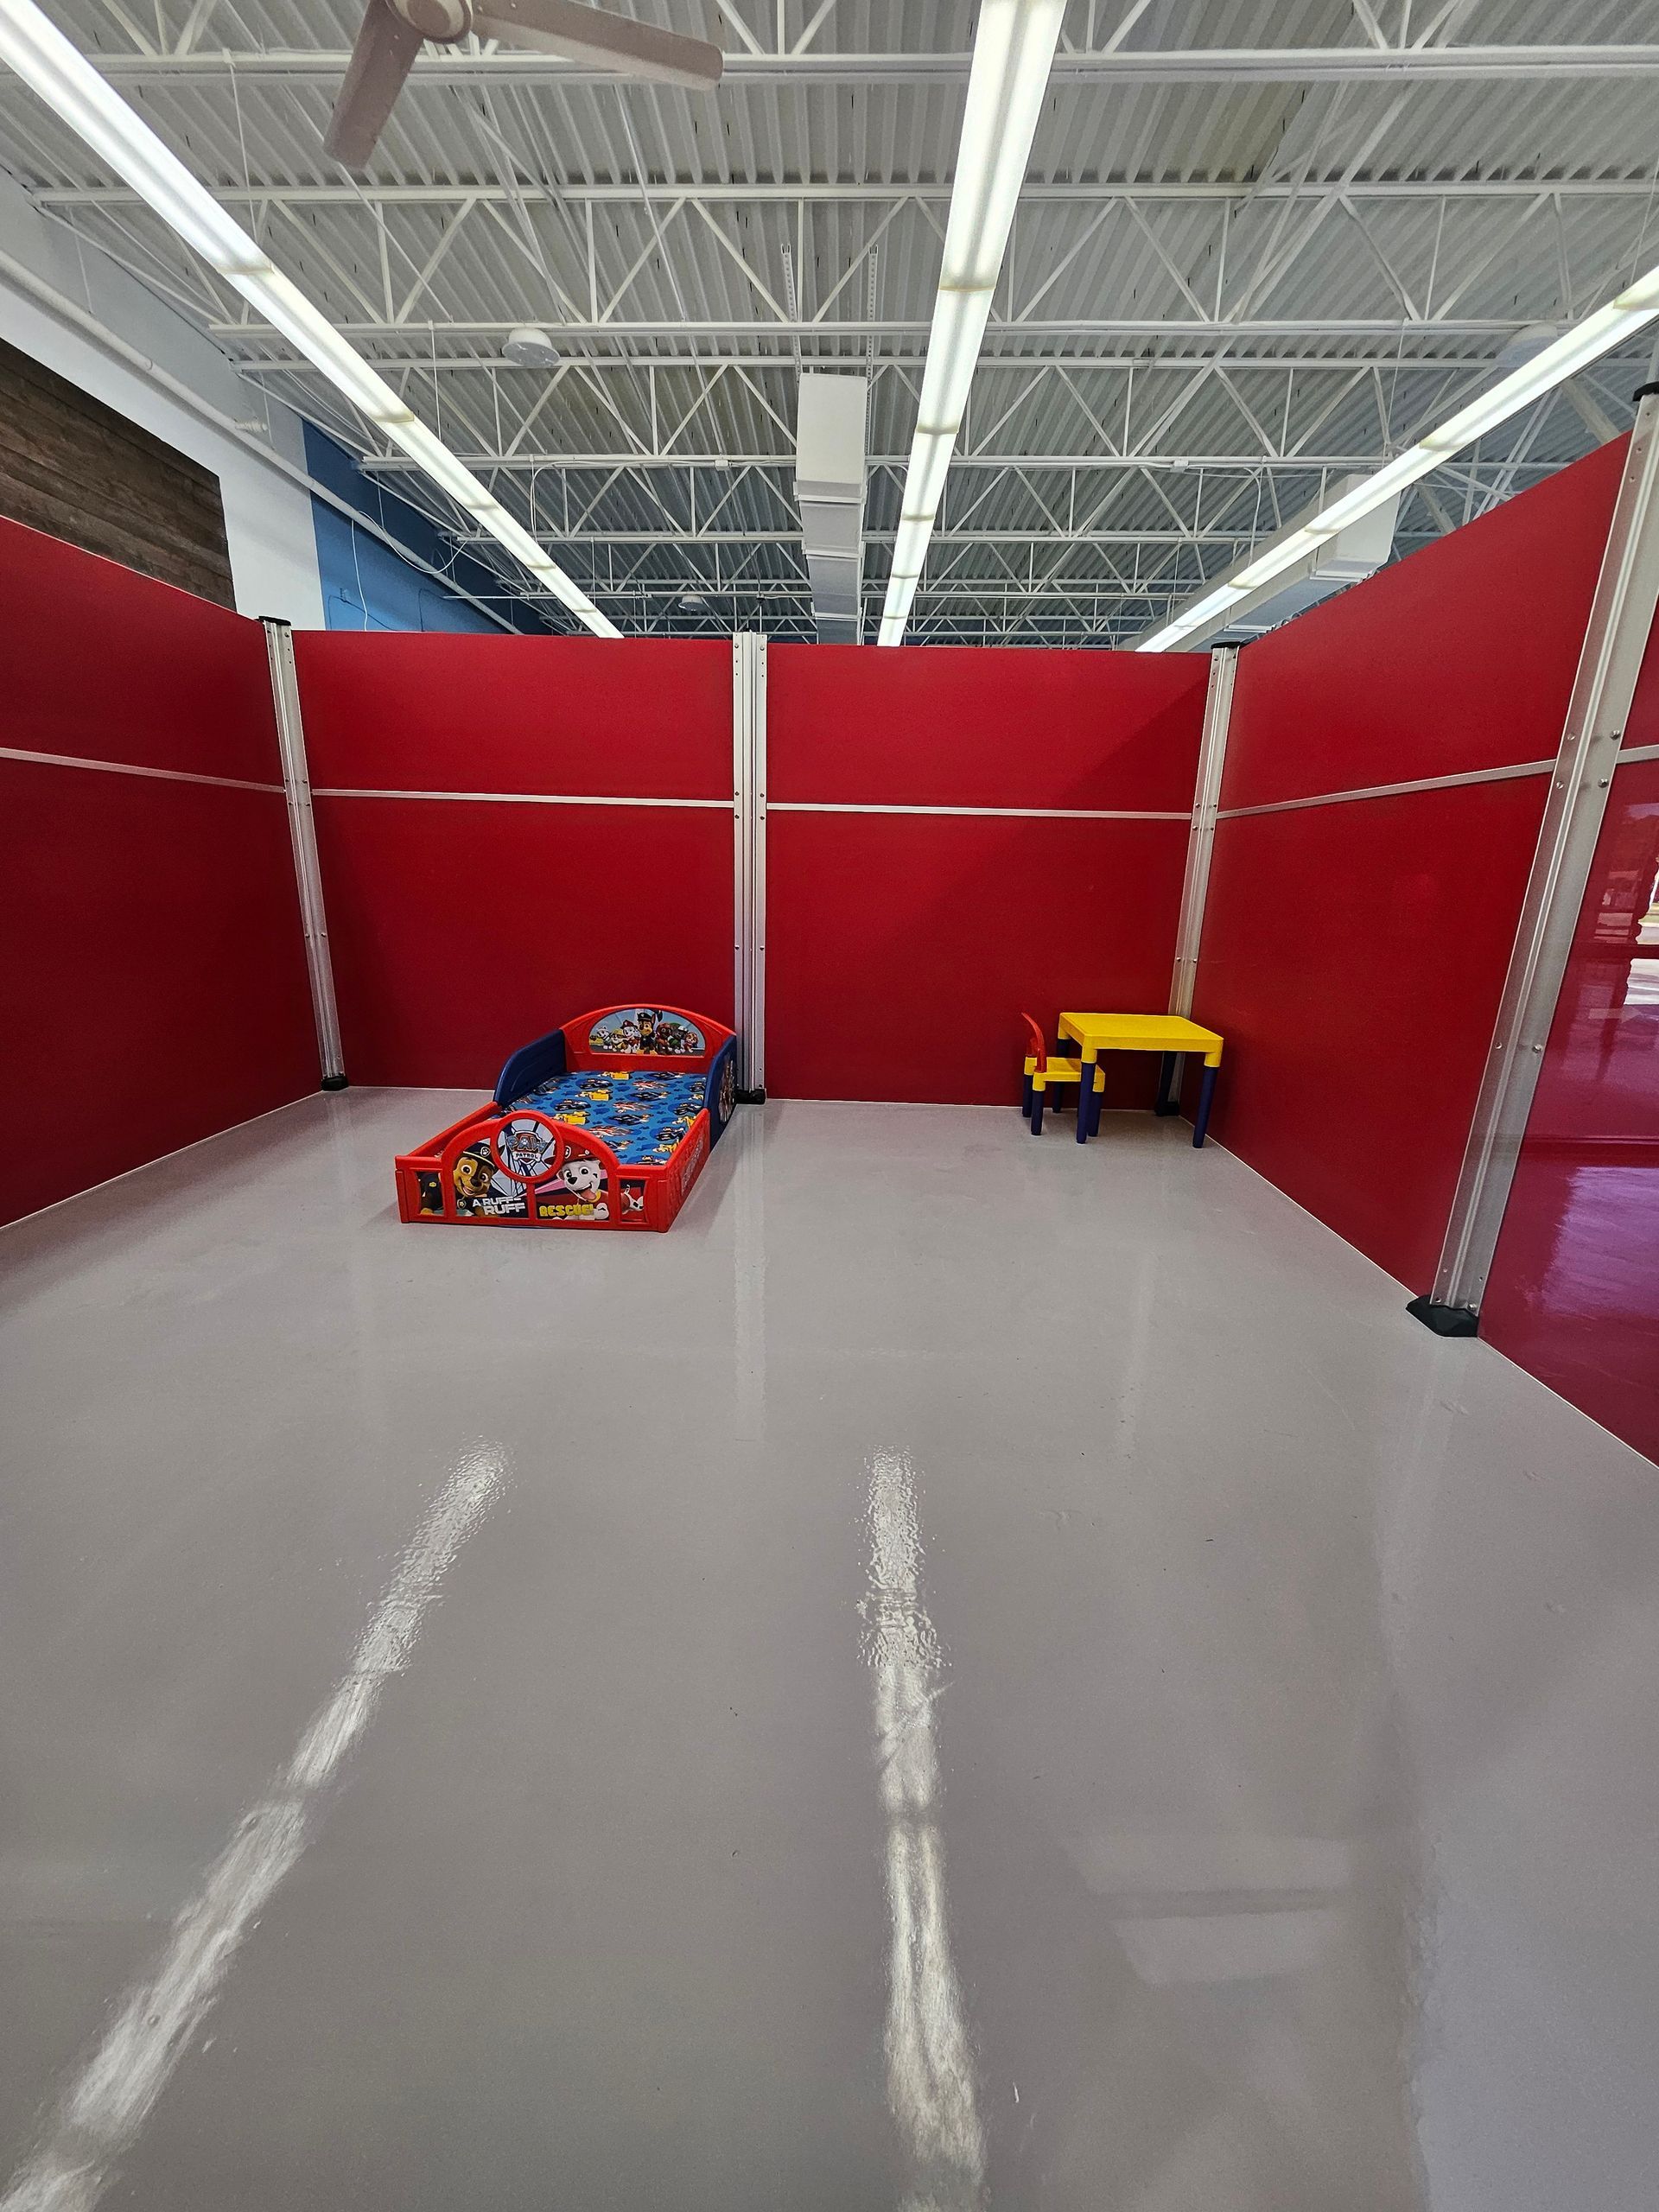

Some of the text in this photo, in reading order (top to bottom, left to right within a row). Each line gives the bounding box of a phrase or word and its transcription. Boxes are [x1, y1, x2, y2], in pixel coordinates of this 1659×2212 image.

[507, 1135, 548, 1154] PAW
[472, 1197, 521, 1207] A RUFF-
[484, 1203, 525, 1215] RUFF
[539, 1205, 594, 1217] RESCUE!
